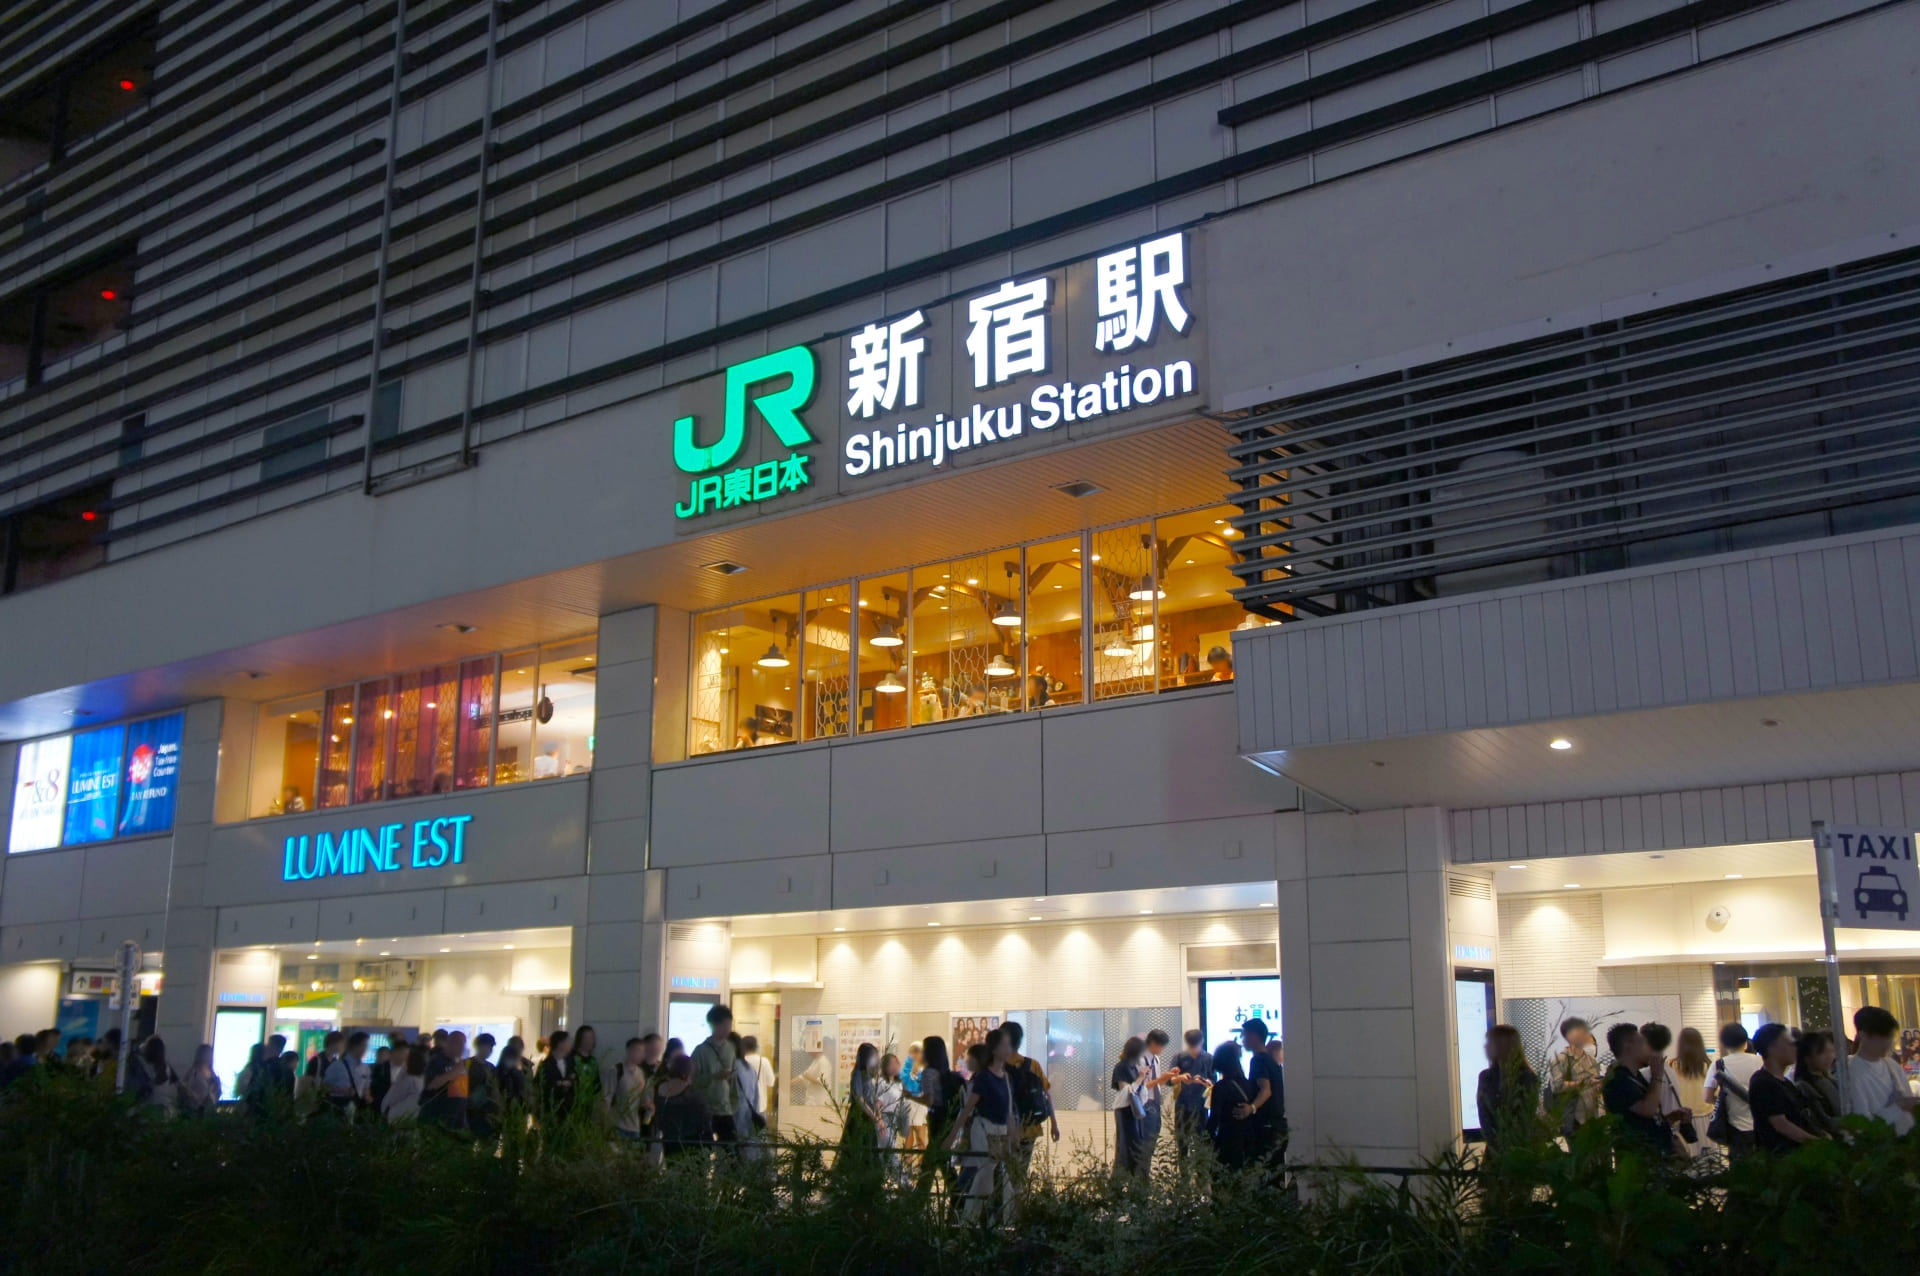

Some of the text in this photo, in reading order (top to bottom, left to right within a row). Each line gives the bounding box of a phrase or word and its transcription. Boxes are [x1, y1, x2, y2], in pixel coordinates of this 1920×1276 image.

[847, 232, 1189, 418] 新宿駅
[674, 345, 814, 472] JR
[845, 359, 1193, 476] Shinjuku Station
[675, 453, 809, 519] JR東日本
[283, 813, 473, 881] LUMINE EST
[1837, 833, 1911, 860] TAXI
